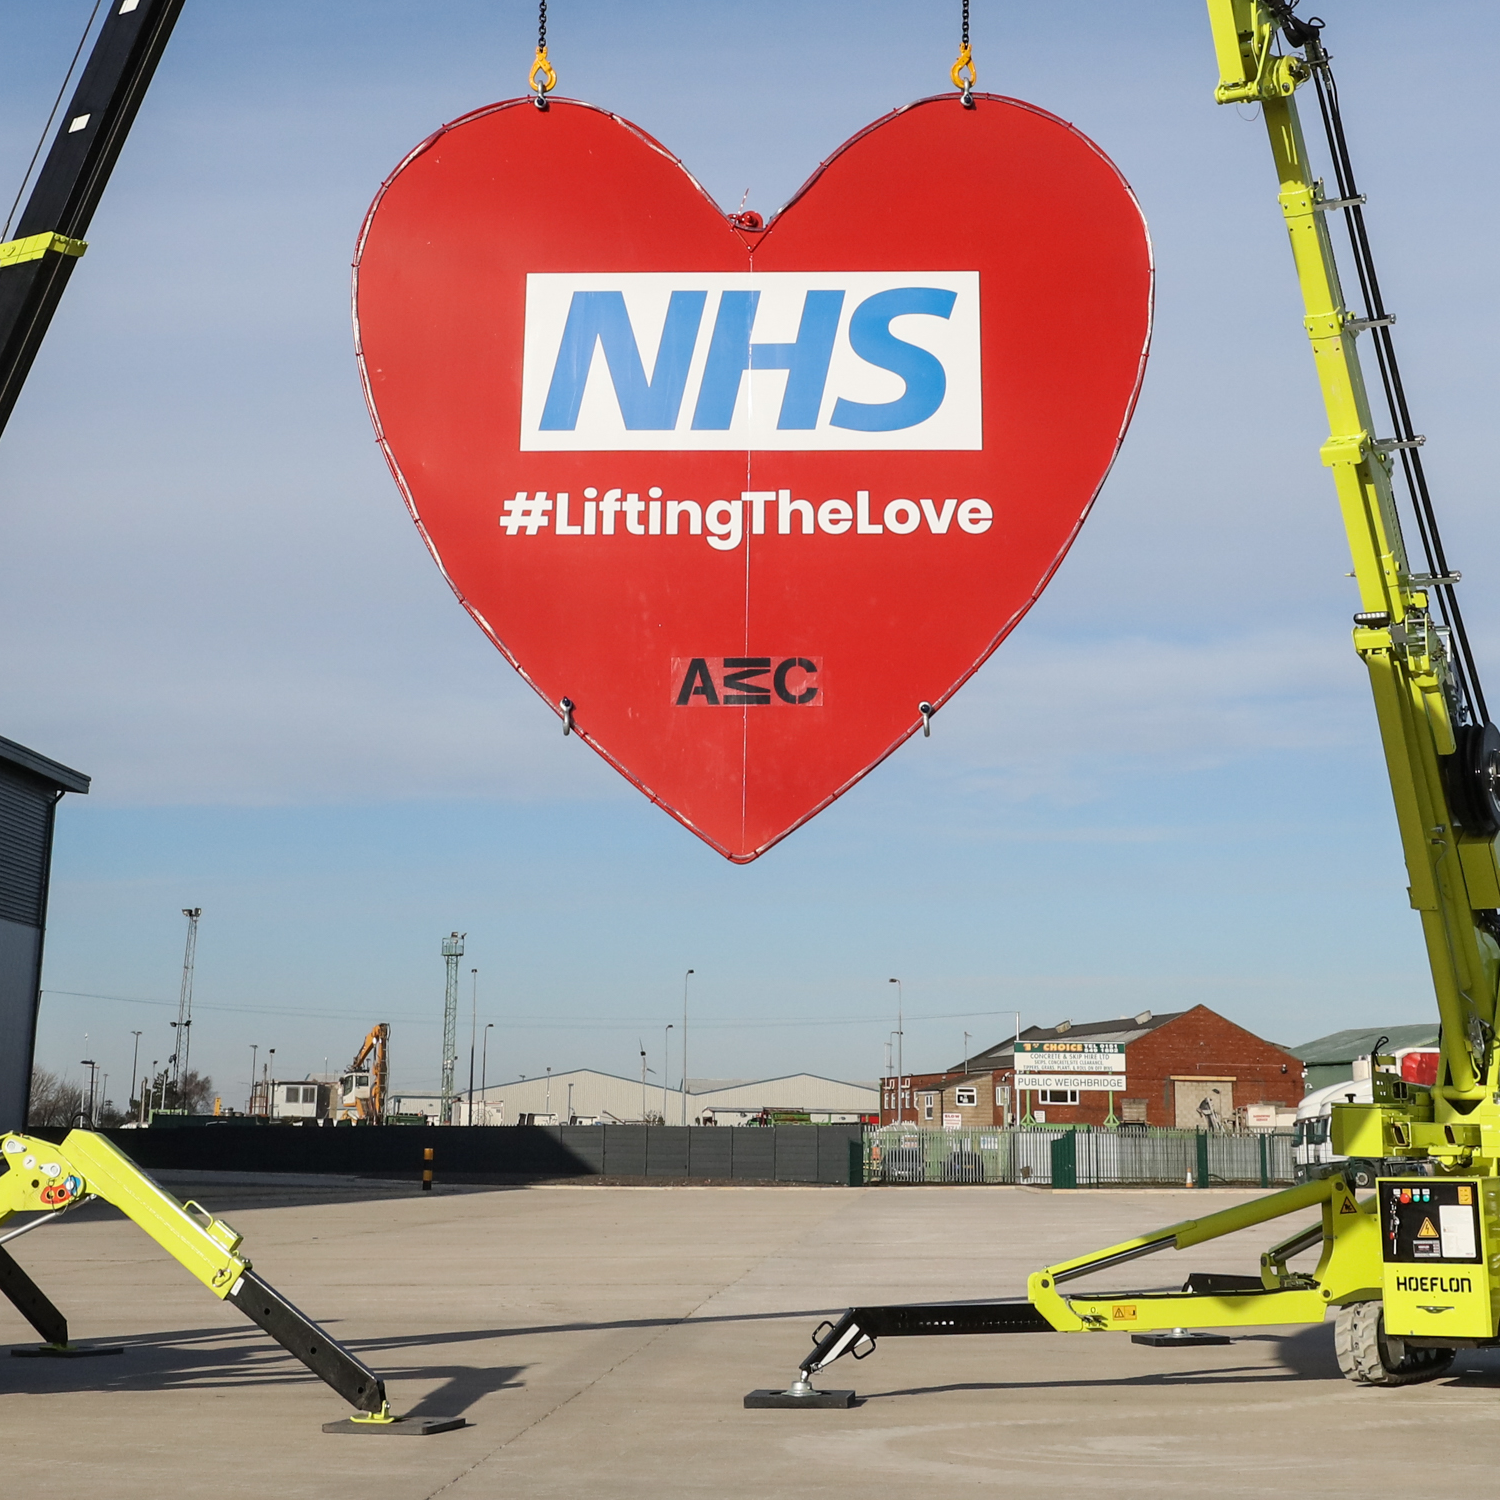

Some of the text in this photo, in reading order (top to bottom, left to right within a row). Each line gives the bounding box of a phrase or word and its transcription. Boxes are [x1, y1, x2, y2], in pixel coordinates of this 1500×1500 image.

[539, 286, 959, 433] NHS
[500, 486, 994, 551] #LiftingTheLove
[1043, 1043, 1083, 1052] CHOICE
[1018, 1078, 1123, 1088] PUBLIC WEIGHBRIDGE
[1396, 1276, 1472, 1293] HOEFLON
